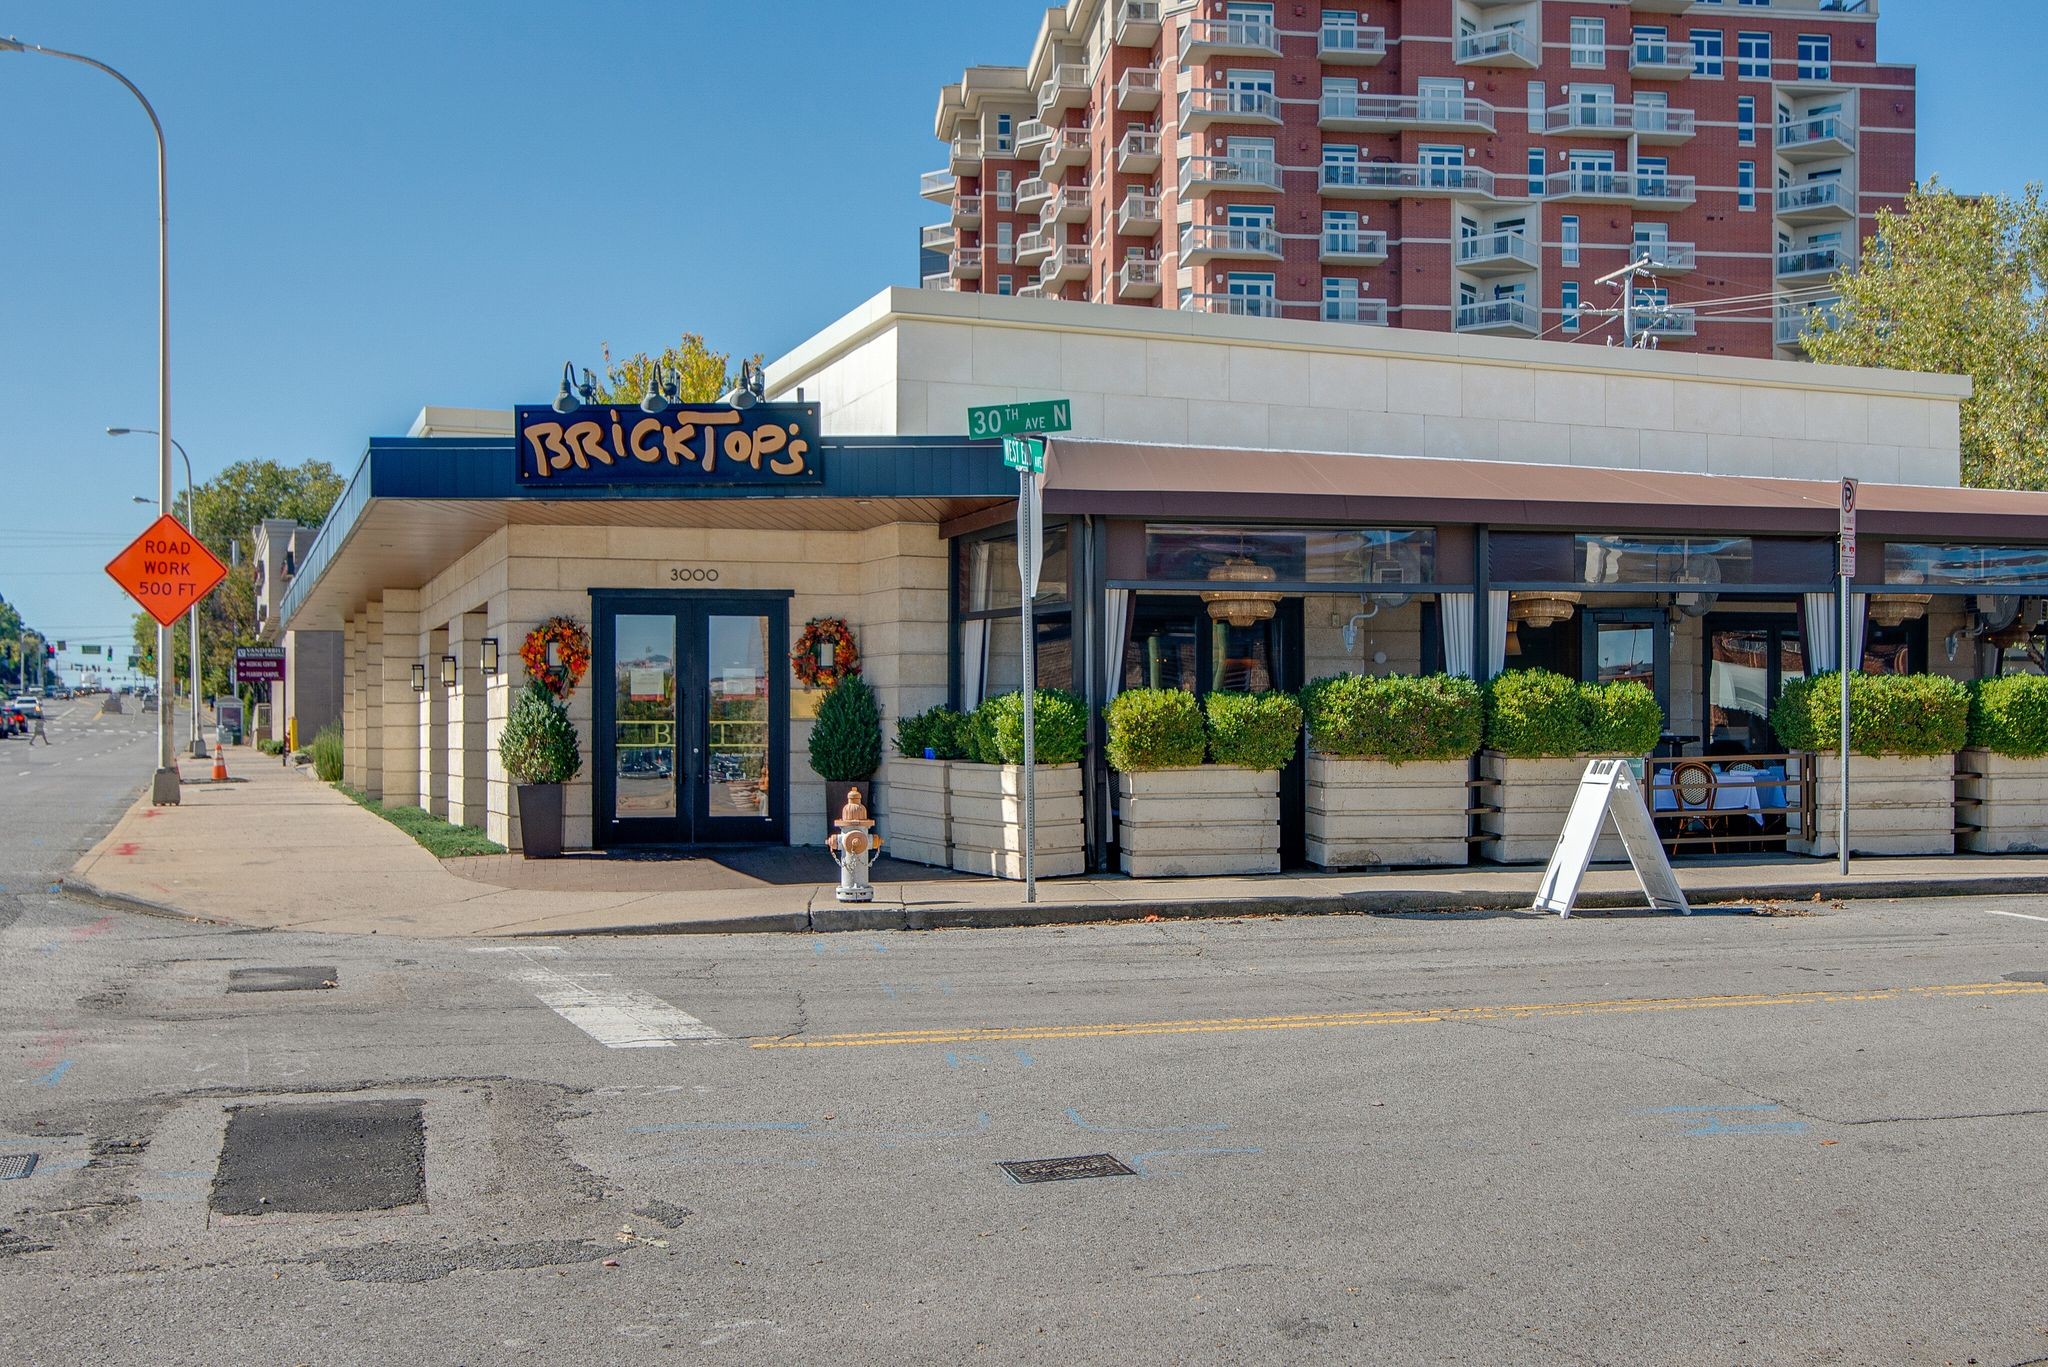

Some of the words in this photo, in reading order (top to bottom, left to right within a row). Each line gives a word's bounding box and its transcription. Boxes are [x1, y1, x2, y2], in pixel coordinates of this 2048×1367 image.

[1025, 417, 1046, 431] AVE
[1053, 404, 1067, 428] N
[1004, 439, 1019, 464] WEST
[145, 540, 191, 555] ROAD
[144, 560, 191, 576] WORK
[670, 567, 720, 582] 3000
[139, 581, 172, 596] 500
[178, 582, 197, 597] FT
[655, 724, 671, 745] B
